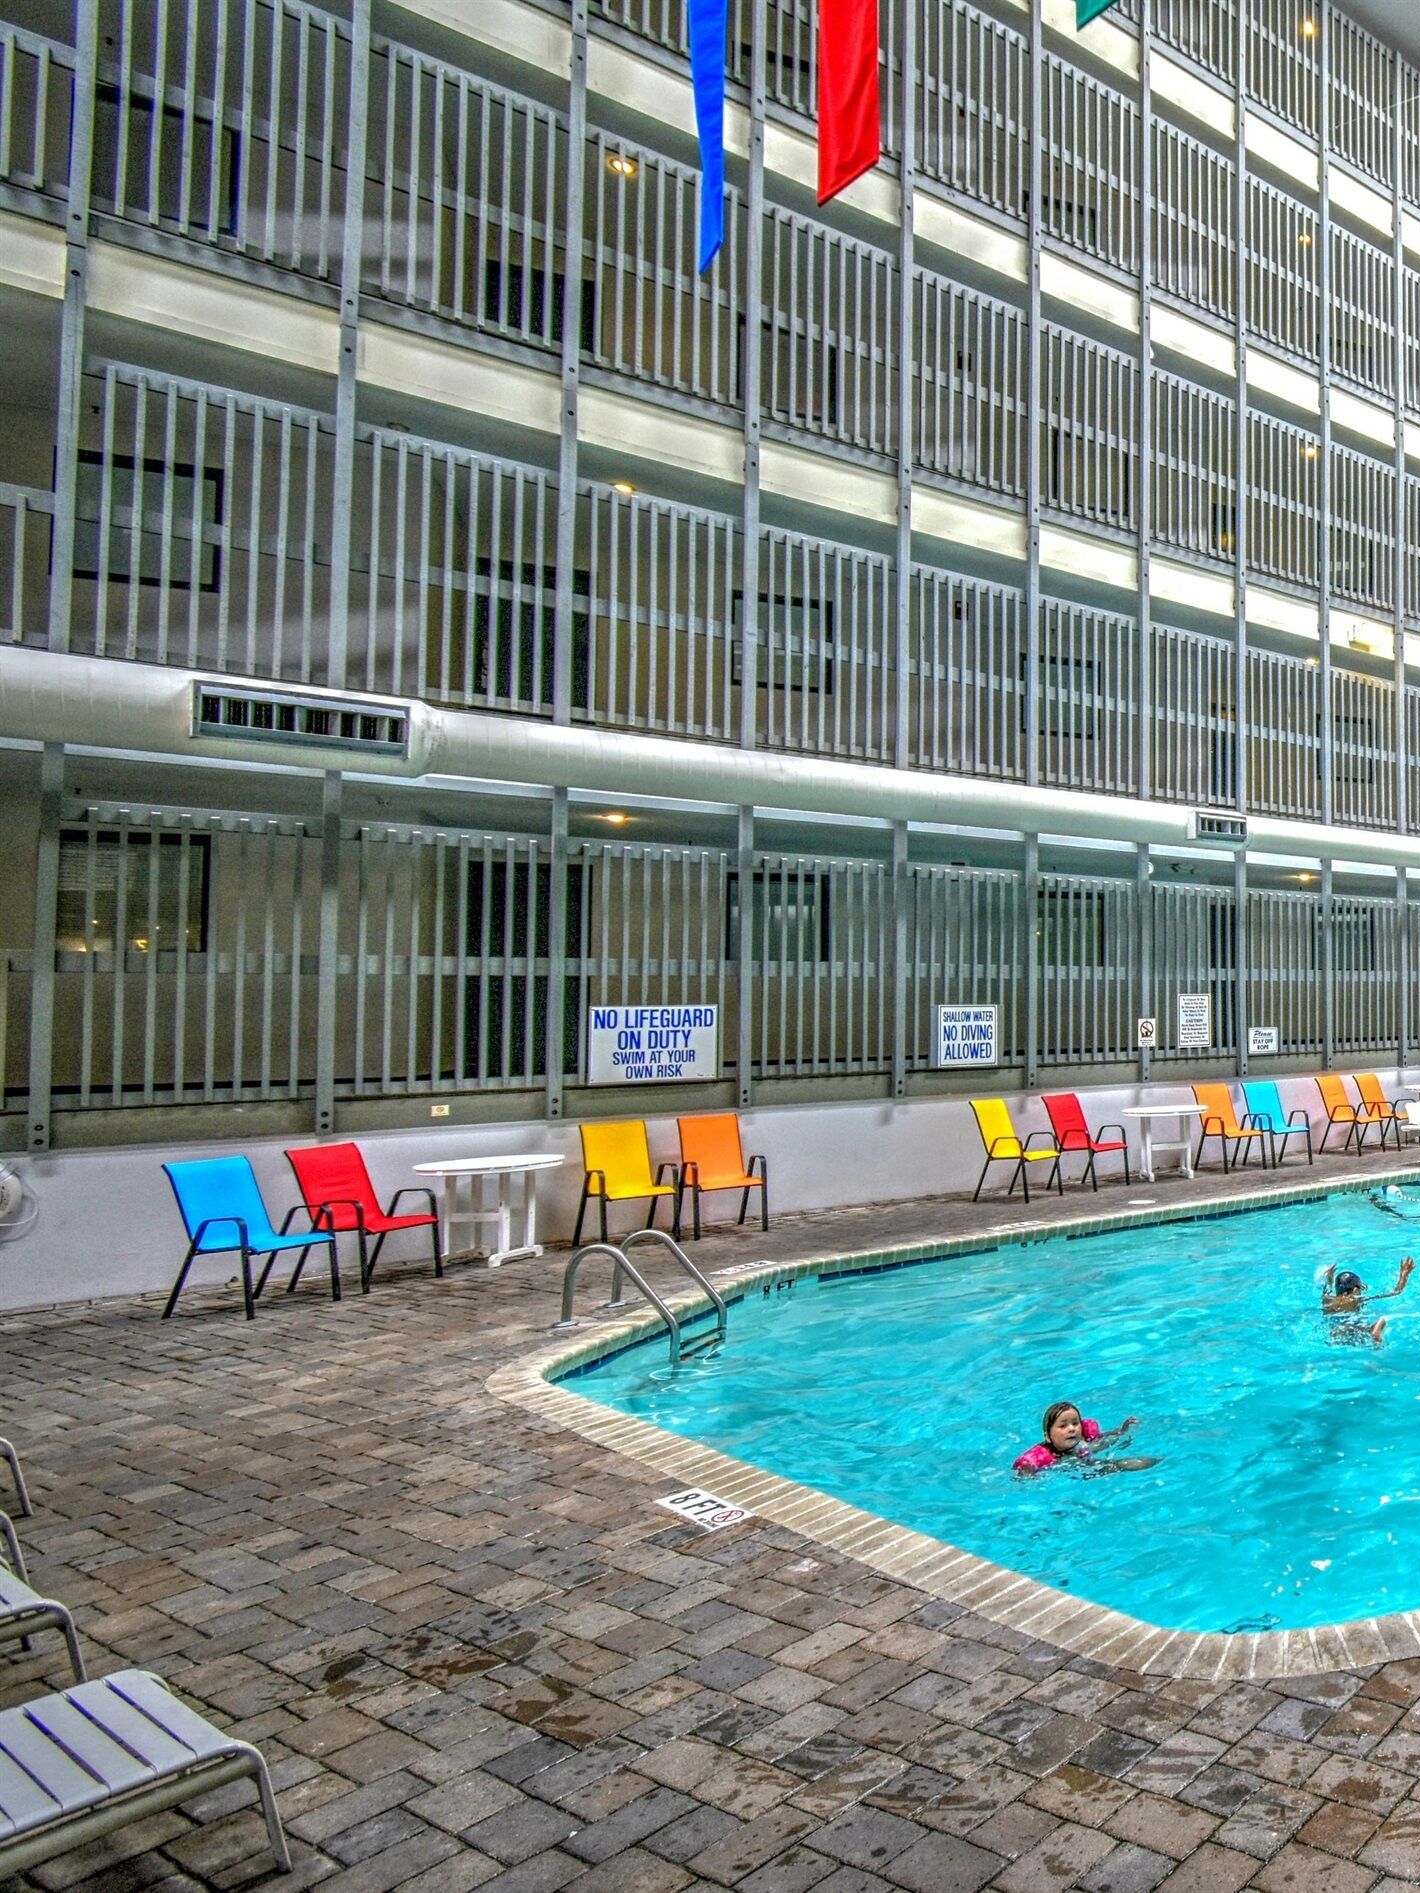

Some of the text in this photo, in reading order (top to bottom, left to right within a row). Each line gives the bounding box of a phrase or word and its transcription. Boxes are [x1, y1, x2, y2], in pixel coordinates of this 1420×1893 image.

[594, 1008, 714, 1029] NO LIFEGUARD
[943, 1010, 993, 1022] SHALLOW WATER
[617, 1029, 691, 1050] ON DUTY
[943, 1024, 993, 1041] NO DIVING
[612, 1050, 695, 1066] SWIM AT YOUR
[944, 1042, 992, 1060] ALLOWED
[625, 1064, 682, 1079] OWN RISK
[668, 1493, 727, 1516] 8 FT
